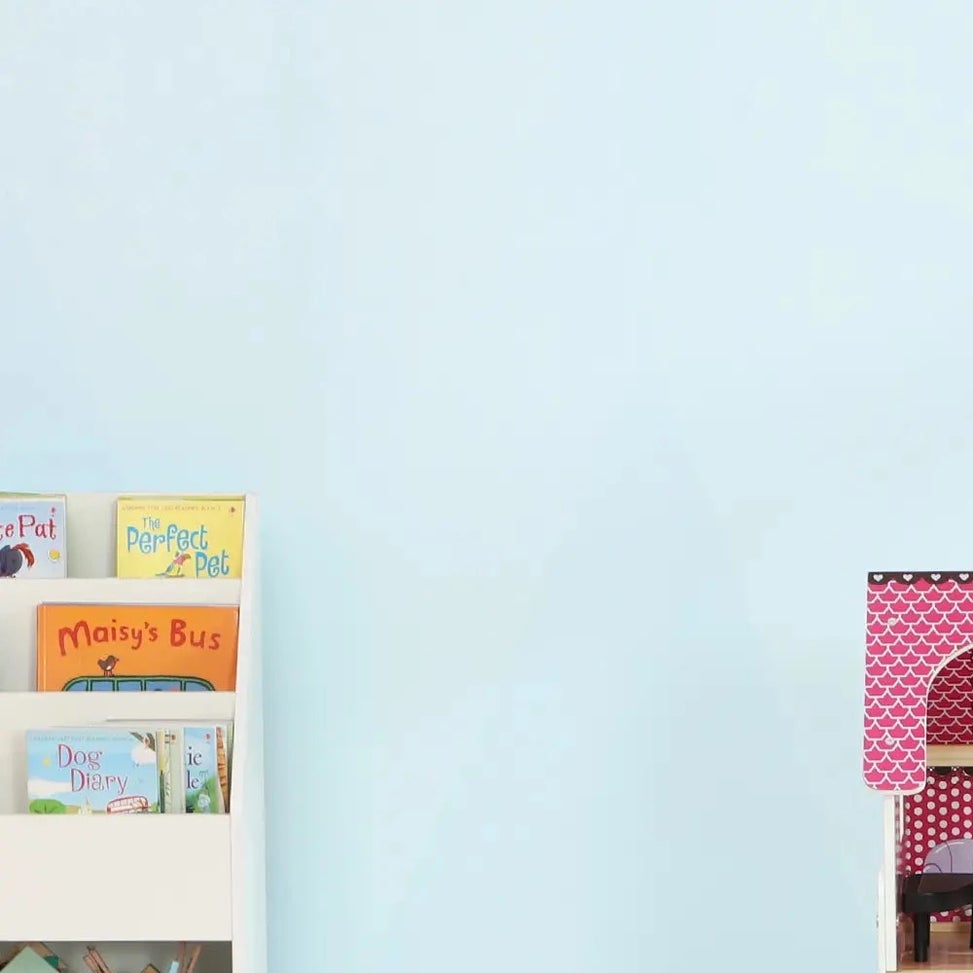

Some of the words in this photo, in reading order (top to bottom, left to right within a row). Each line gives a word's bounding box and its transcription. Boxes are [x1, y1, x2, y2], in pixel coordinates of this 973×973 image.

[18, 514, 56, 540] Pat
[143, 516, 160, 530] The
[127, 524, 208, 553] Perfect
[195, 549, 230, 578] Pet
[58, 619, 158, 656] Maisy's
[170, 619, 221, 650] Bus
[58, 743, 103, 770] Dog
[71, 768, 128, 795] Diary
